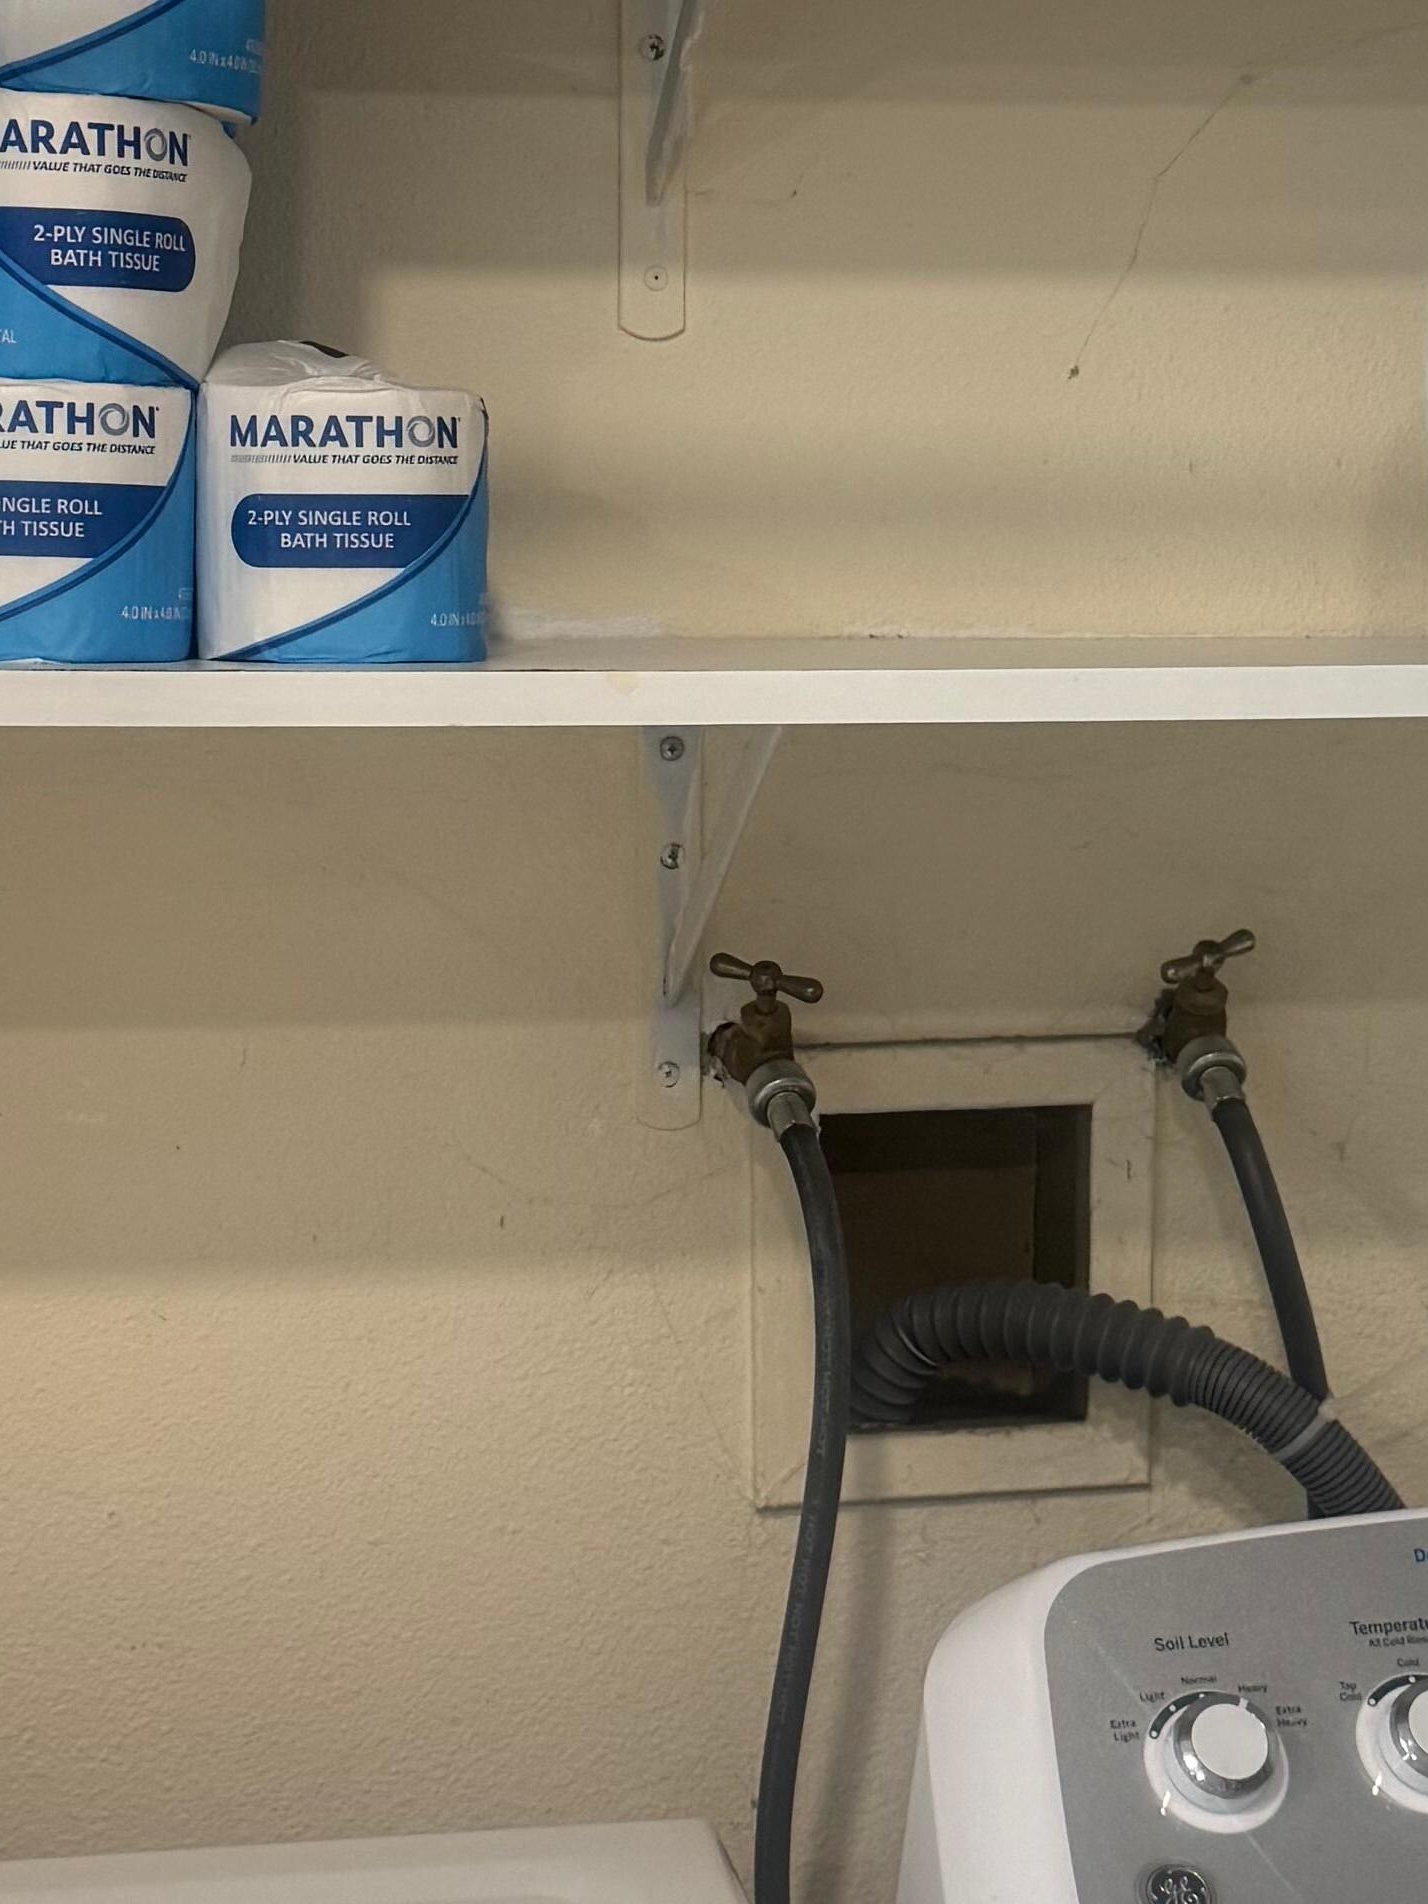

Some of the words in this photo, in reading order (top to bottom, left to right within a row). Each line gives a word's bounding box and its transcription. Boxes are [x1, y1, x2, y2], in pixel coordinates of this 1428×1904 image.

[230, 415, 458, 448] MARATHON
[248, 510, 292, 526] 2-PLY
[298, 511, 361, 526] SINGLE
[368, 512, 411, 526] ROLL
[281, 534, 327, 548] BATH
[334, 534, 394, 548] TISSUE
[1154, 1636, 1184, 1651] Soil
[1188, 1633, 1229, 1649] Level
